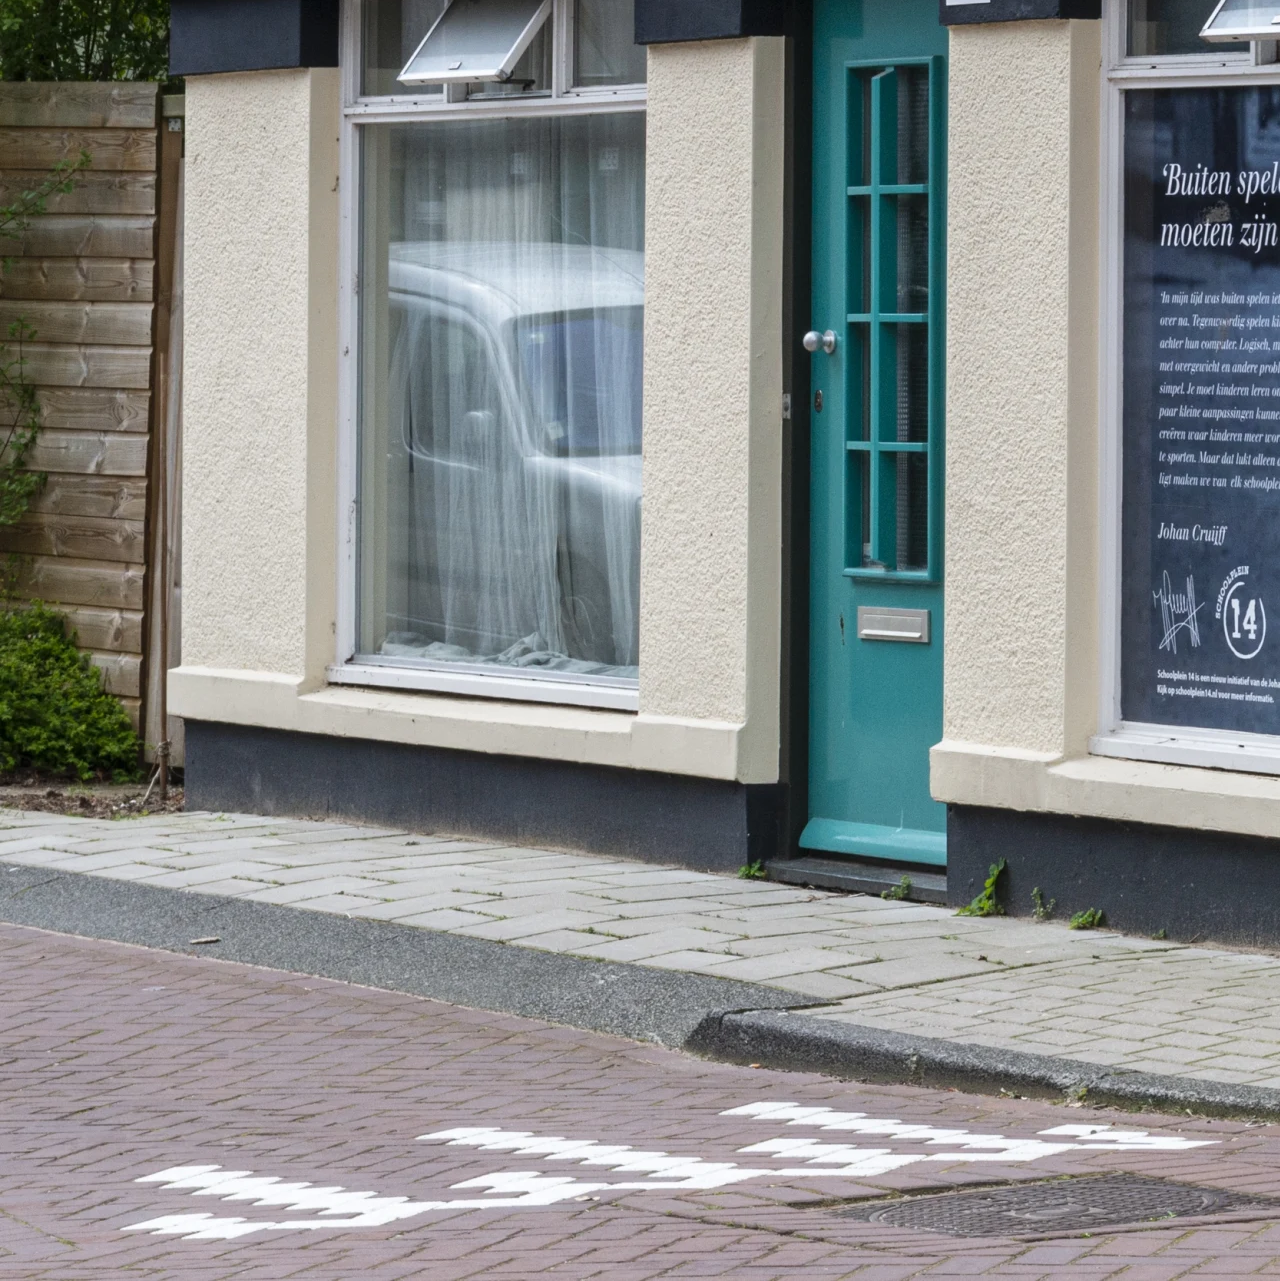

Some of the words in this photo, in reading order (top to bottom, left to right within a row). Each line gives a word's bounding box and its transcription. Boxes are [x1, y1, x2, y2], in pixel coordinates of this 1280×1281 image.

[1160, 218, 1234, 247] moeten
[1239, 213, 1278, 254] zijn
[1172, 291, 1189, 306] mijn
[1190, 291, 1203, 306] tijd
[1204, 295, 1220, 303] was
[1221, 291, 1245, 304] buiten
[1246, 292, 1270, 307] spelen
[1160, 318, 1177, 326] over
[1246, 315, 1270, 331] spelen
[1160, 337, 1183, 349] achter
[1185, 337, 1199, 349] hun
[1160, 360, 1173, 371] met
[1175, 359, 1220, 376] overgewicht
[1221, 364, 1231, 373] en
[1232, 361, 1258, 373] andere
[1157, 522, 1189, 540] Johan
[1192, 524, 1228, 546] Cruijff
[1215, 565, 1249, 619] SCHOOLPLEIN
[1231, 599, 1257, 639] 14
[1158, 670, 1187, 684] Schoolplein
[1188, 672, 1194, 682] 14
[1195, 673, 1199, 683] is
[1201, 675, 1210, 684] een
[1211, 674, 1226, 685] nieuw
[1227, 675, 1249, 686] initiatief
[1251, 679, 1260, 687] van
[1261, 678, 1267, 688] de
[1157, 684, 1167, 697] Kijk
[1168, 687, 1175, 698] op
[1176, 686, 1217, 701] schoolplein14.nl
[1218, 691, 1230, 699] voor
[1231, 692, 1244, 701] meer
